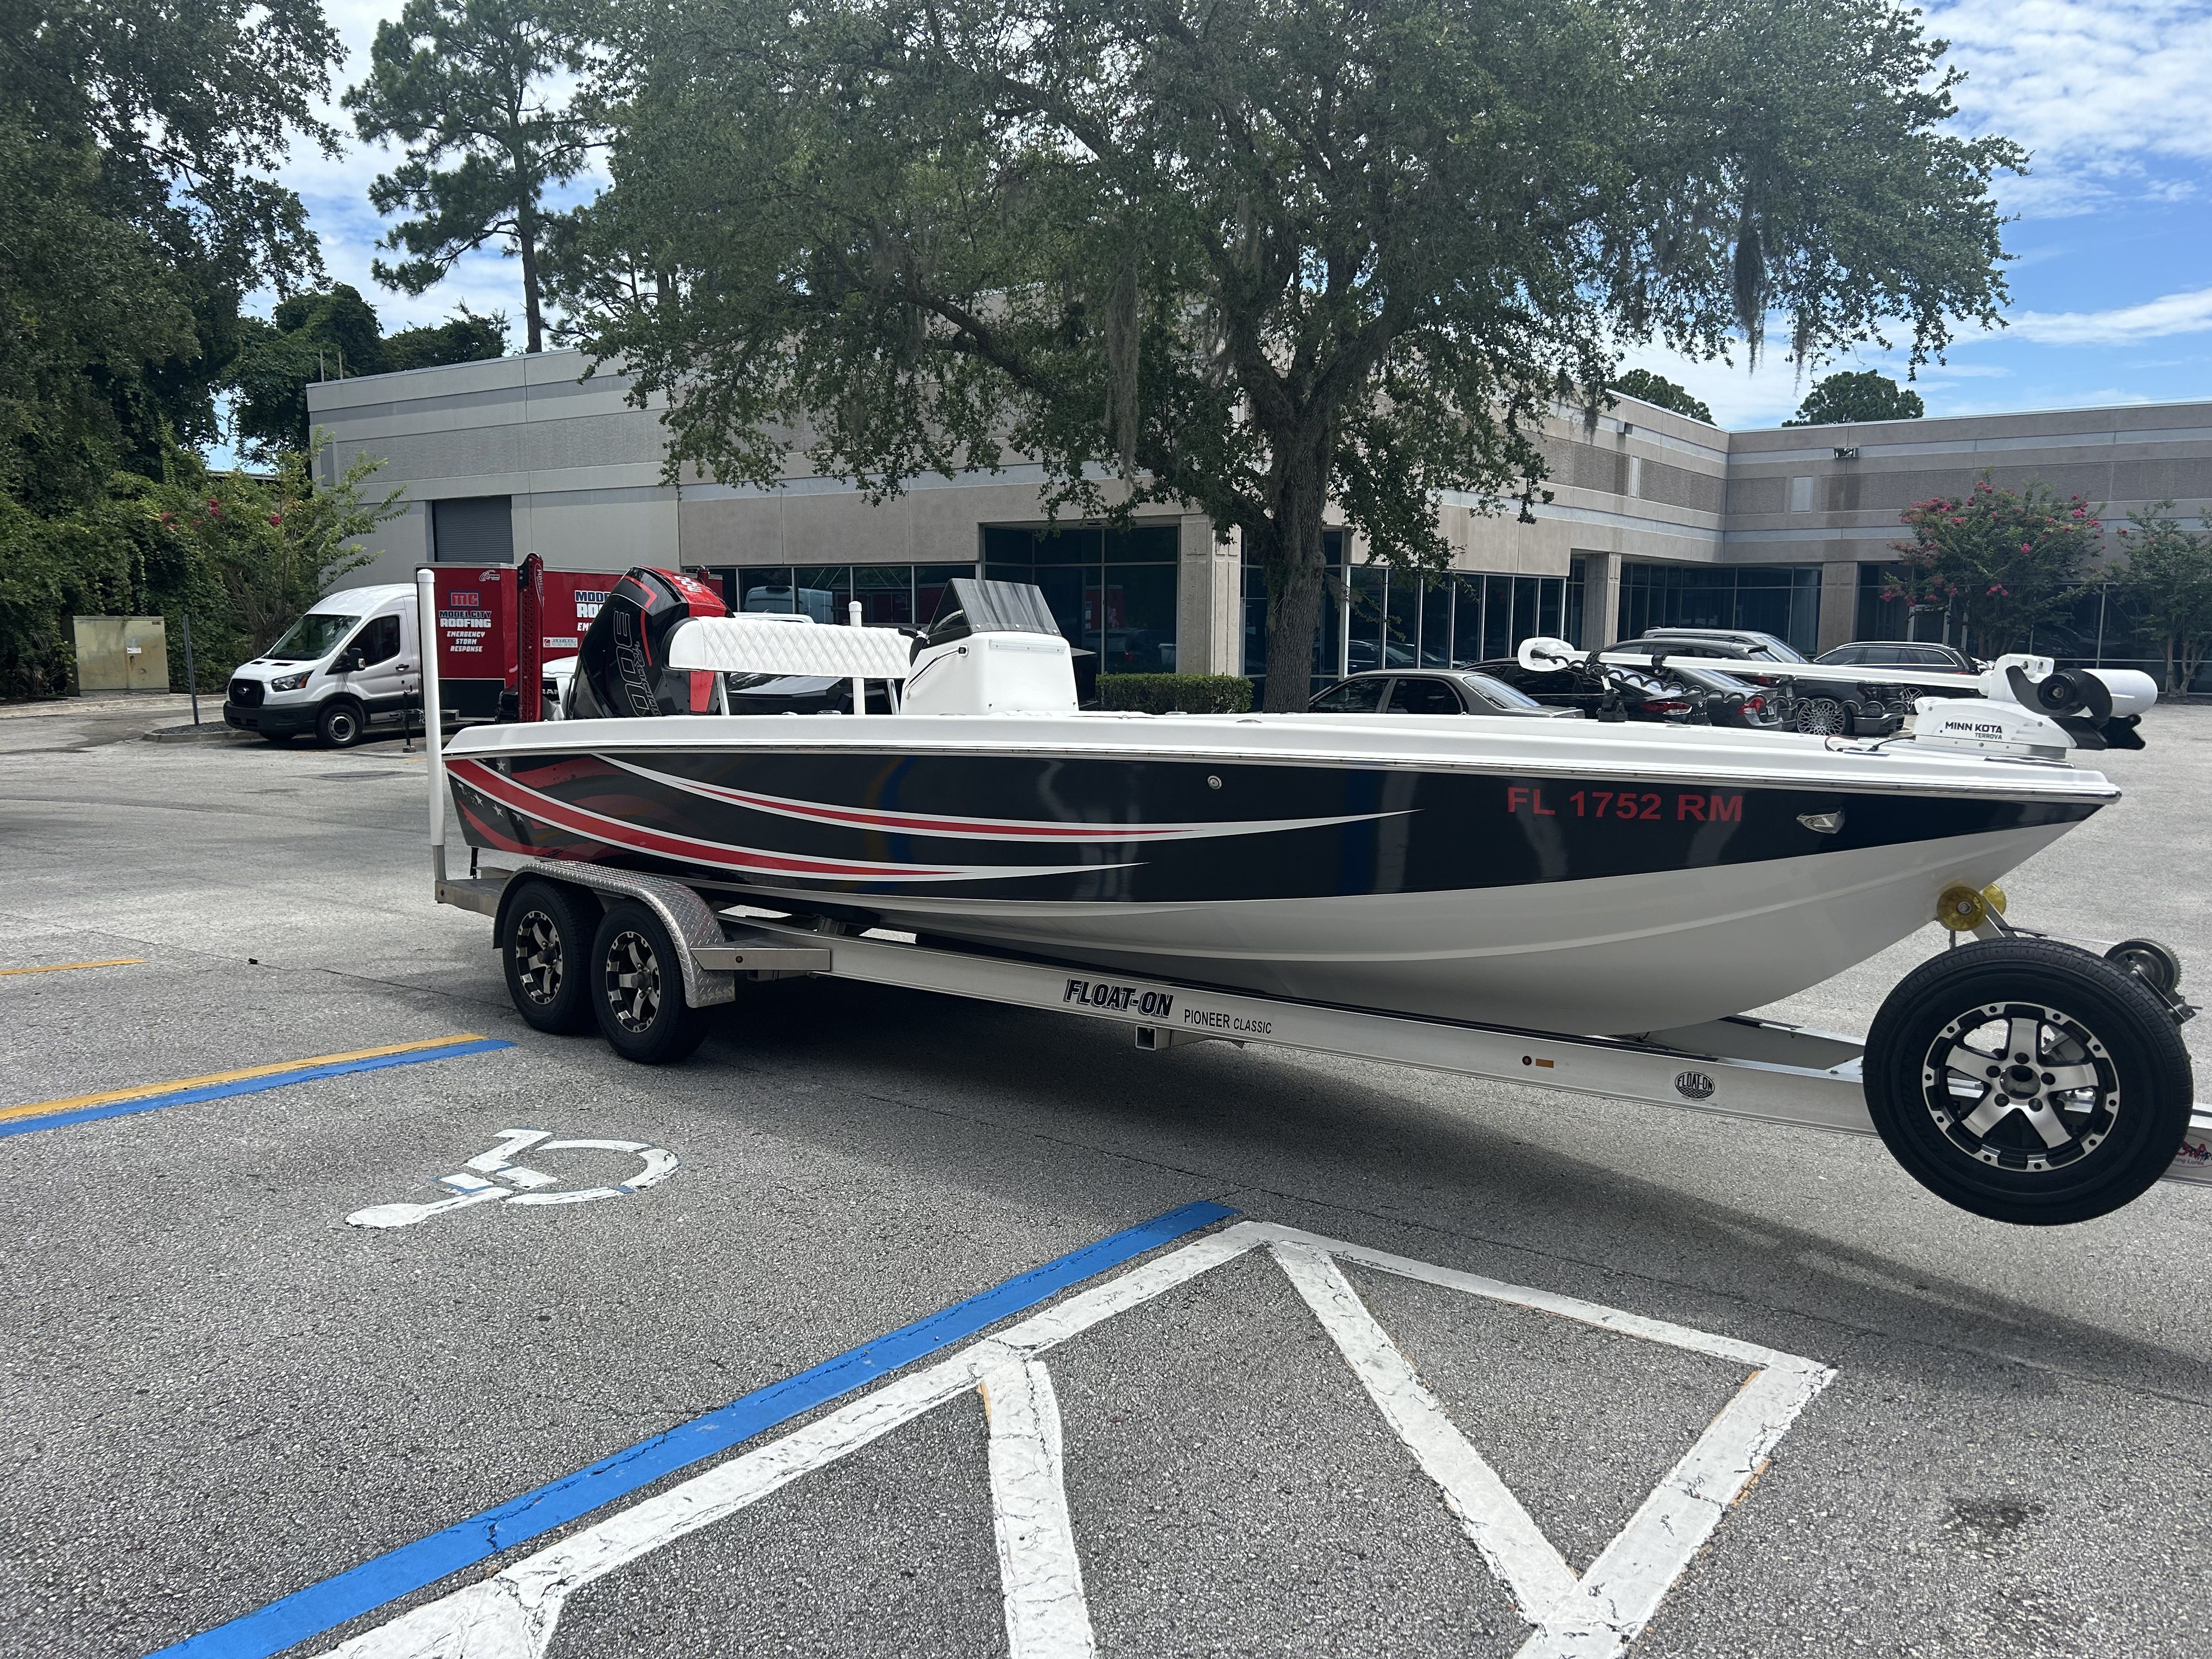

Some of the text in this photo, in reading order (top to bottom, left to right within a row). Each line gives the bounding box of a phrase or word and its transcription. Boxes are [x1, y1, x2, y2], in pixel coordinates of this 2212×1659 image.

[440, 618, 492, 628] ROOFING
[1945, 721, 2002, 733] MINN KOTA
[1508, 787, 1743, 822] FL 1752 RM
[1063, 978, 1174, 1019] FLOAT-ON
[1184, 1008, 1272, 1035] PIONEER CLASSIC
[1677, 1073, 1713, 1091] FLOAT-ON
